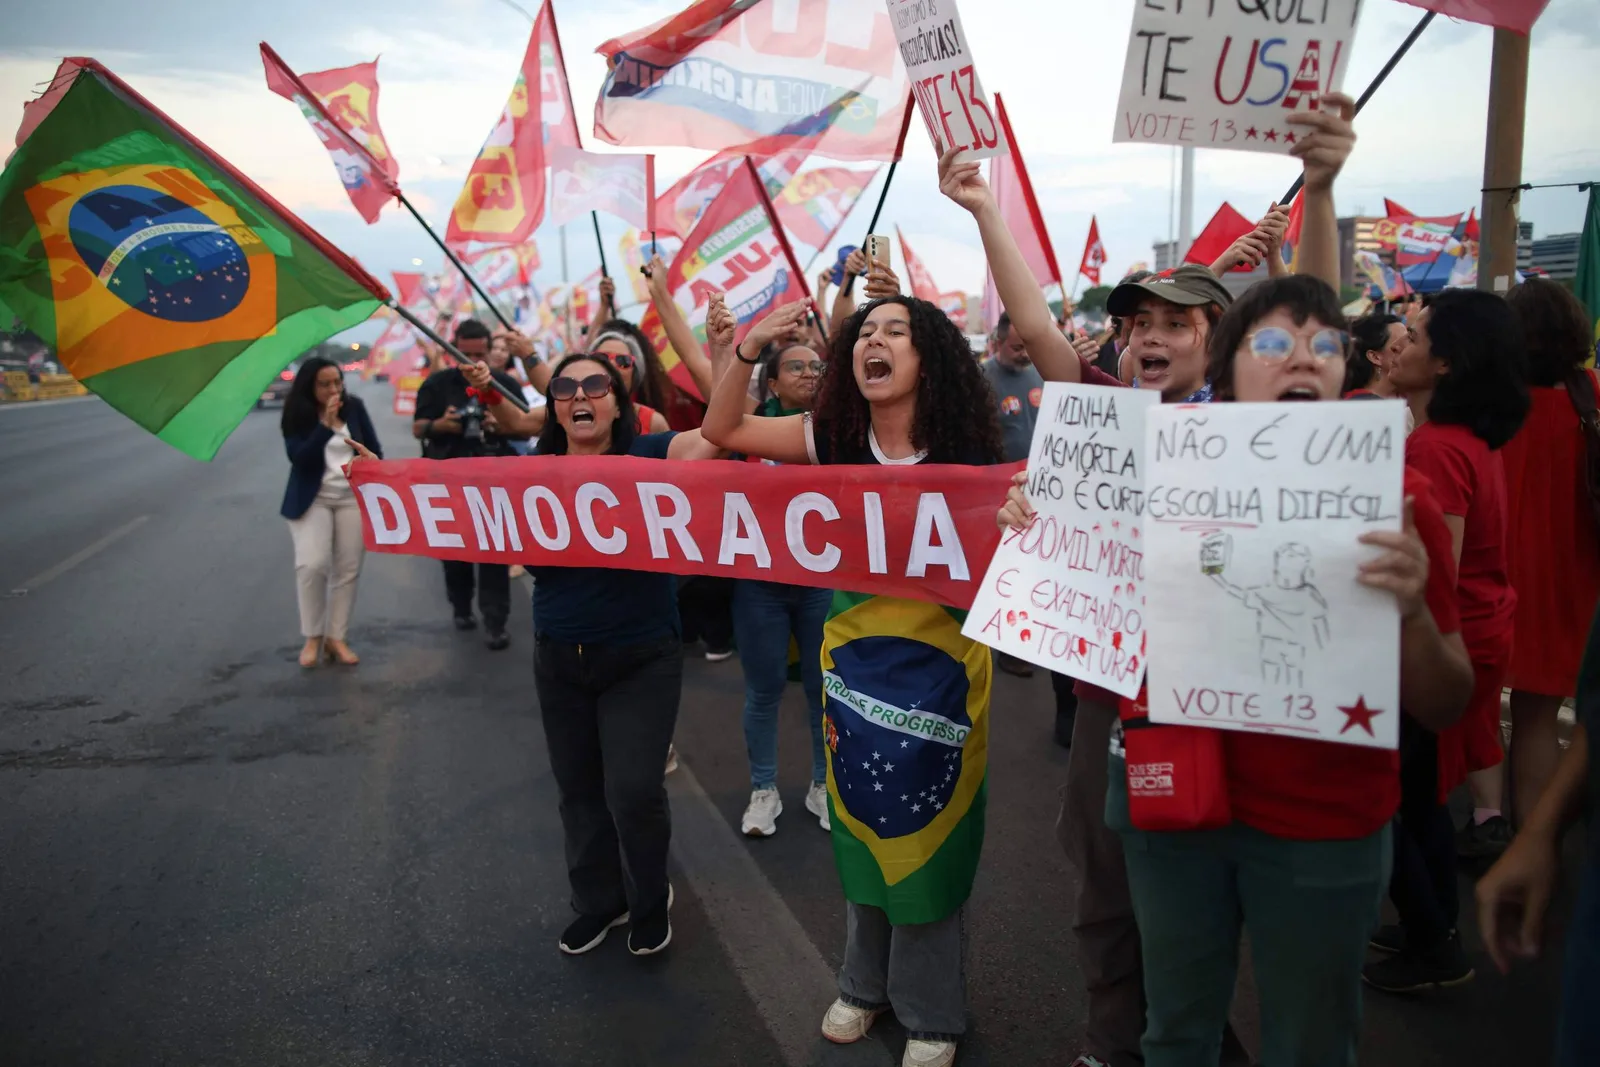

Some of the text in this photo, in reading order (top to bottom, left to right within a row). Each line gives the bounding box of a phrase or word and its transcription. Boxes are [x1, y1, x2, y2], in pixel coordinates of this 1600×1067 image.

[1136, 29, 1343, 110] TE USA!
[951, 64, 998, 149] 13
[1125, 111, 1238, 142] VOTE 13
[1055, 394, 1120, 431] MINHA
[1039, 431, 1137, 479] MEMÓRIA
[1156, 413, 1393, 466] NÃO É UMA
[1022, 466, 1064, 501] NÃO
[1147, 485, 1397, 523] ESCOLHA DIFÍCIL
[358, 481, 972, 582] DEMOCRACIA
[996, 568, 1142, 635] E EXALTANDO
[1032, 619, 1139, 686] TORTURA
[870, 704, 968, 744] PROGRESSO
[1173, 687, 1317, 721] VOTE 13
